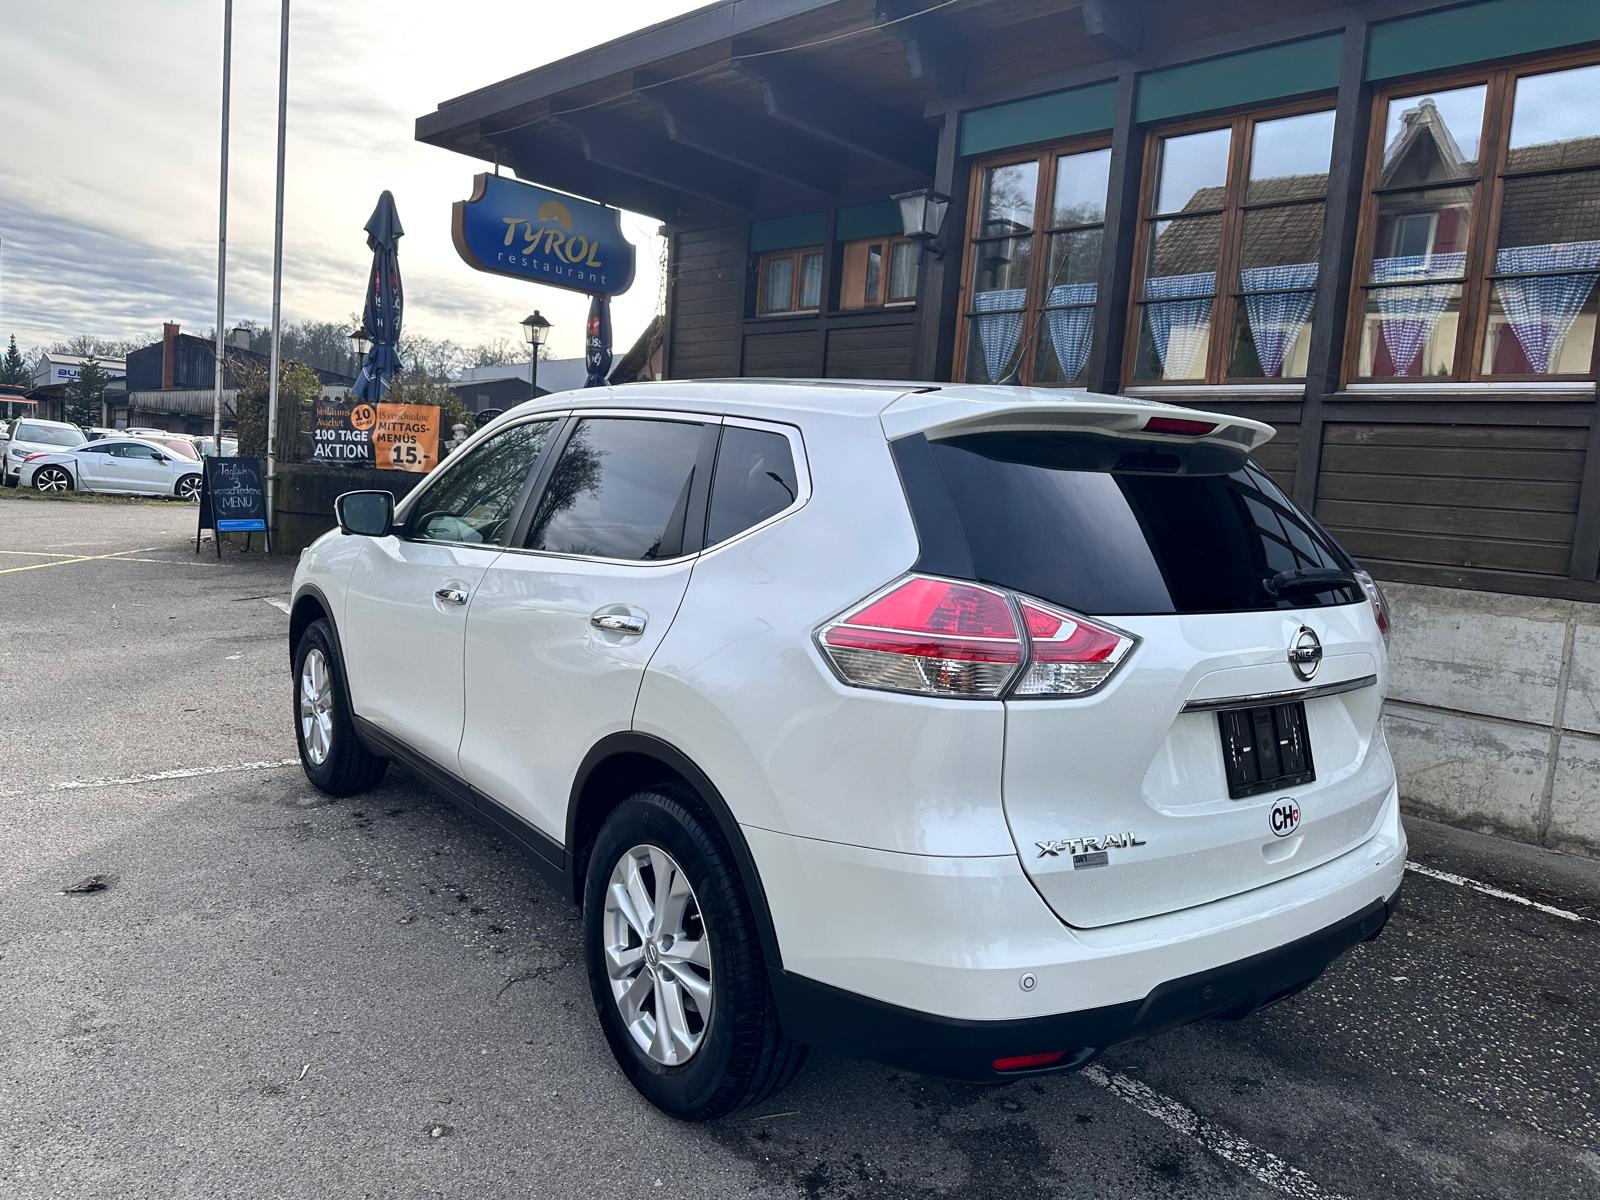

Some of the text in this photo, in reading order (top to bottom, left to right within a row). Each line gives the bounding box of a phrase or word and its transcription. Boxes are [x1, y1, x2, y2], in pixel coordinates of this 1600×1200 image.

[503, 217, 602, 267] TYROL
[498, 251, 608, 285] restaurant
[354, 408, 371, 421] 10
[378, 422, 431, 433] MITTAGS-
[315, 429, 369, 442] 100 TAGE
[377, 433, 417, 444] MENÜS
[313, 443, 369, 458] AKTION
[1272, 804, 1294, 831] CH
[1034, 832, 1147, 858] X-TRAIL
